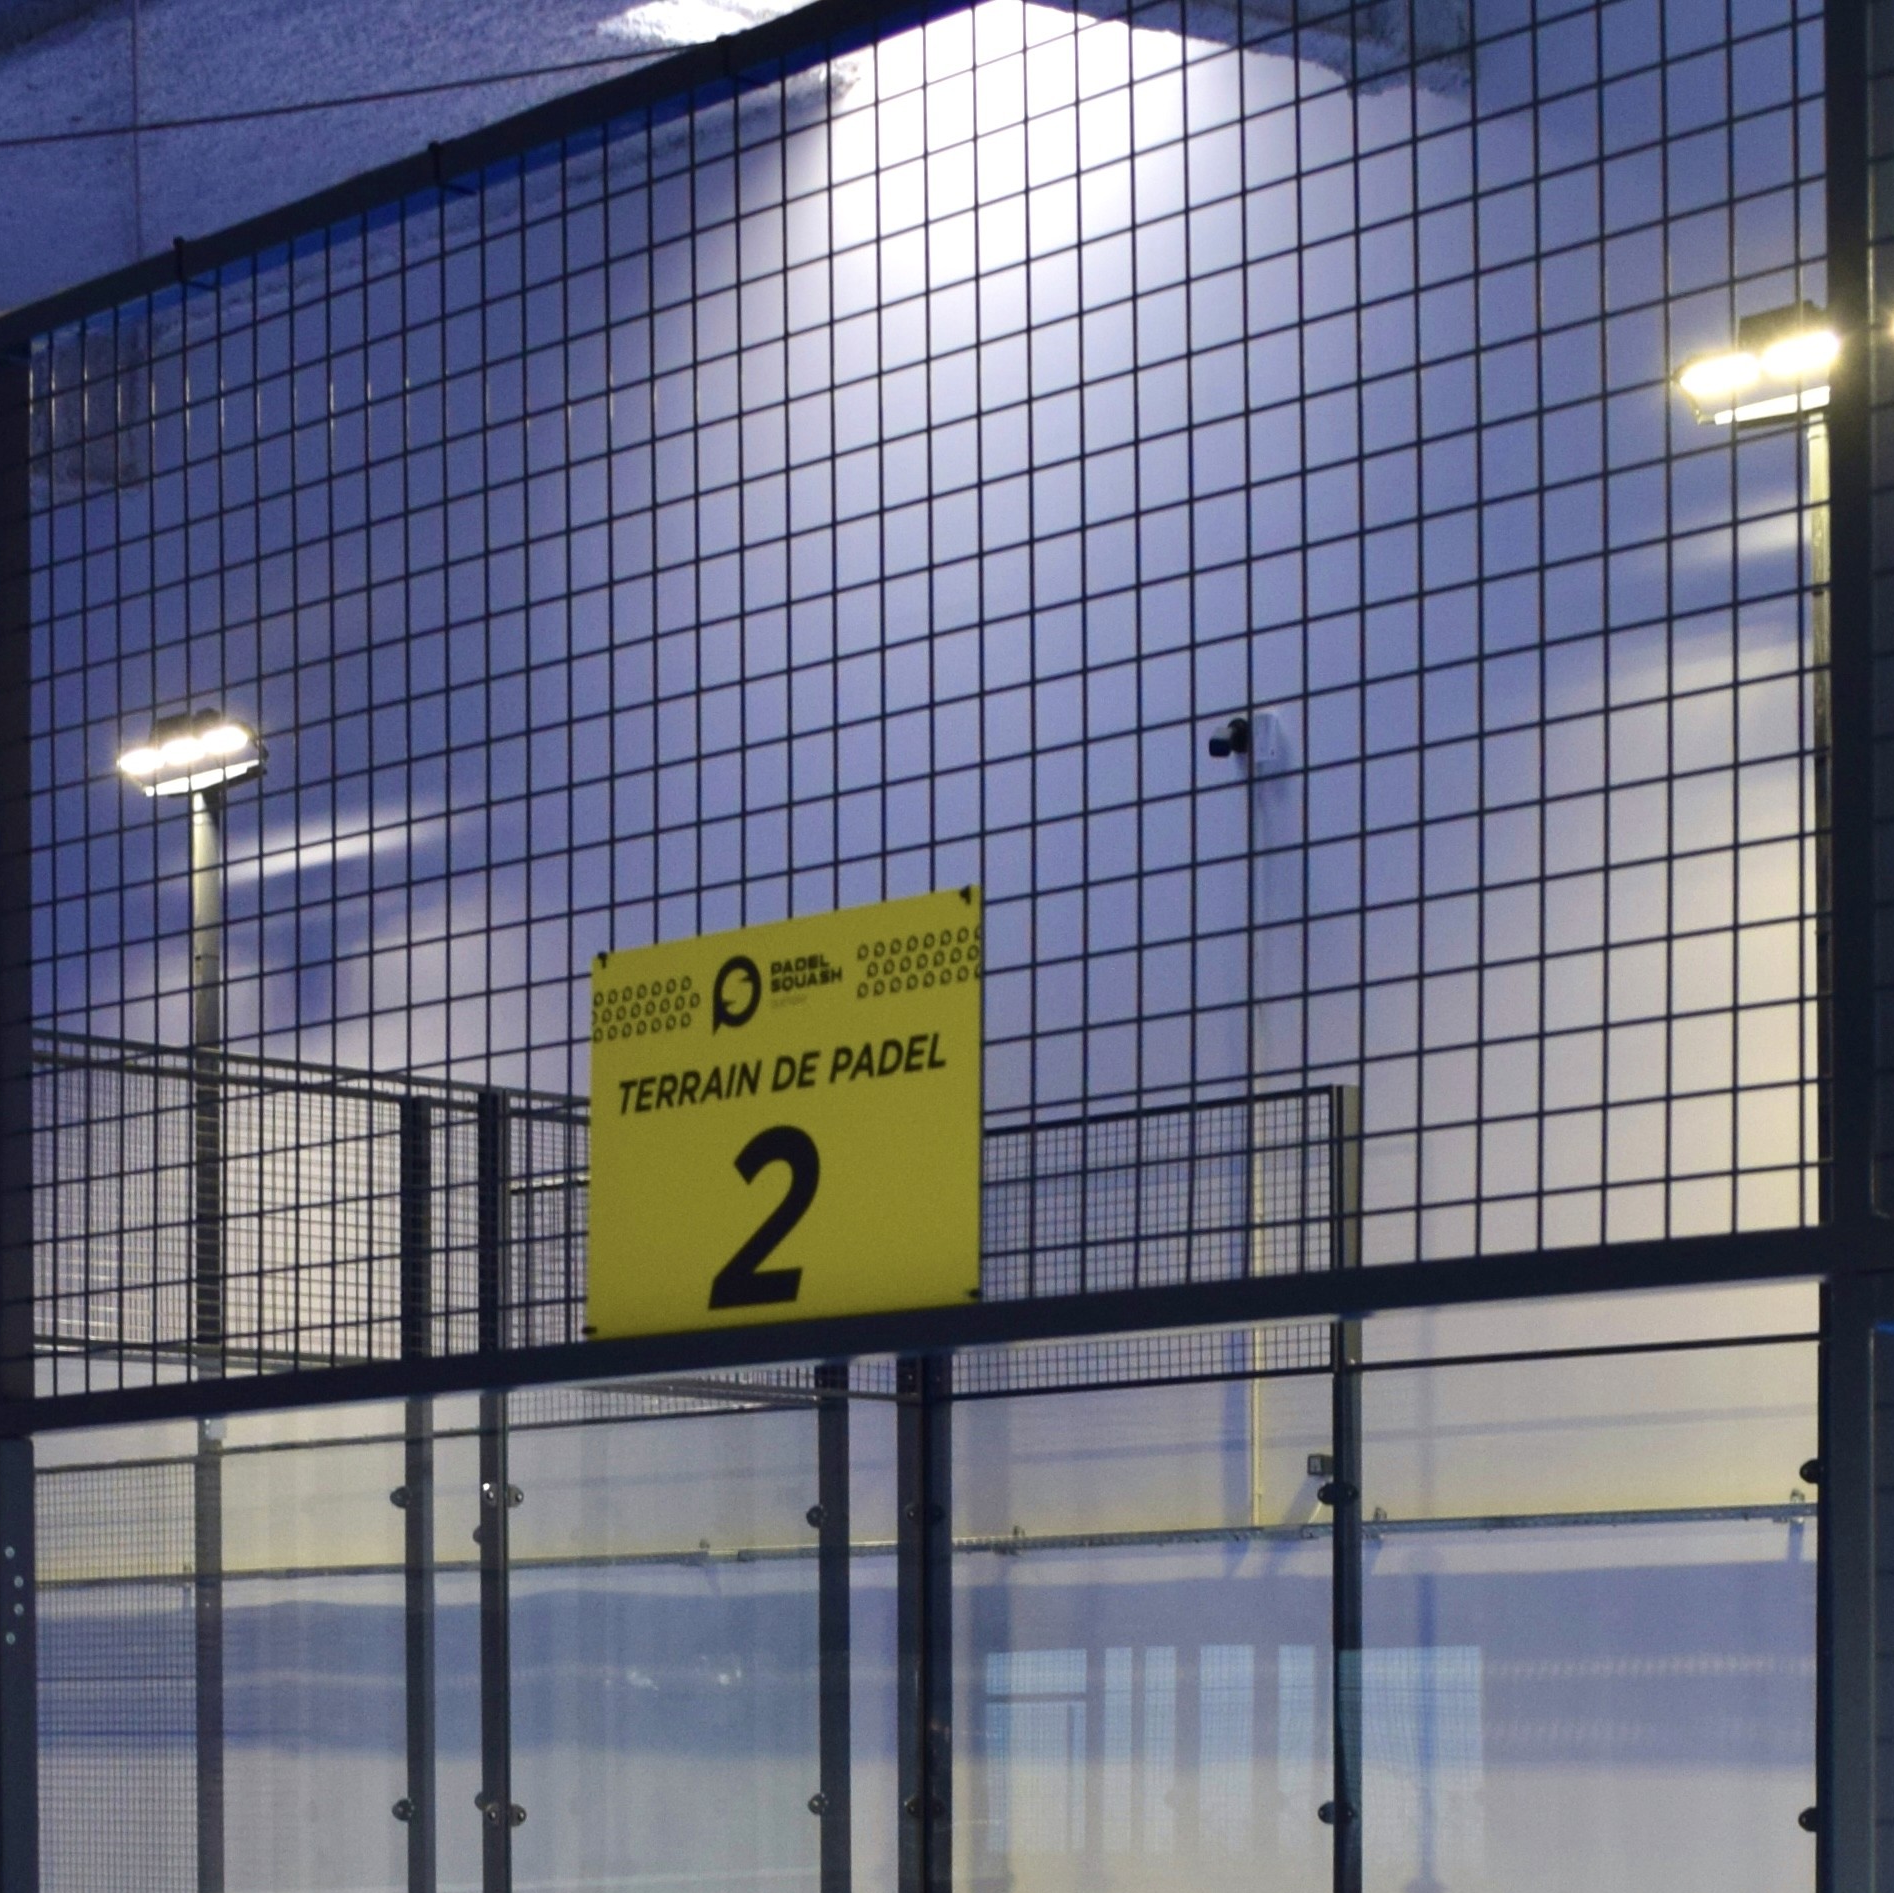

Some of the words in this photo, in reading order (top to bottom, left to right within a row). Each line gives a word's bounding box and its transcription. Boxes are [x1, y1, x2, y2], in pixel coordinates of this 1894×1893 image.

[770, 954, 831, 976] PADEL
[770, 966, 843, 993] SQUASH
[618, 1059, 763, 1116] TERRAIN
[771, 1050, 821, 1093] DE
[828, 1032, 947, 1084] PADEL
[707, 1124, 821, 1311] 2
